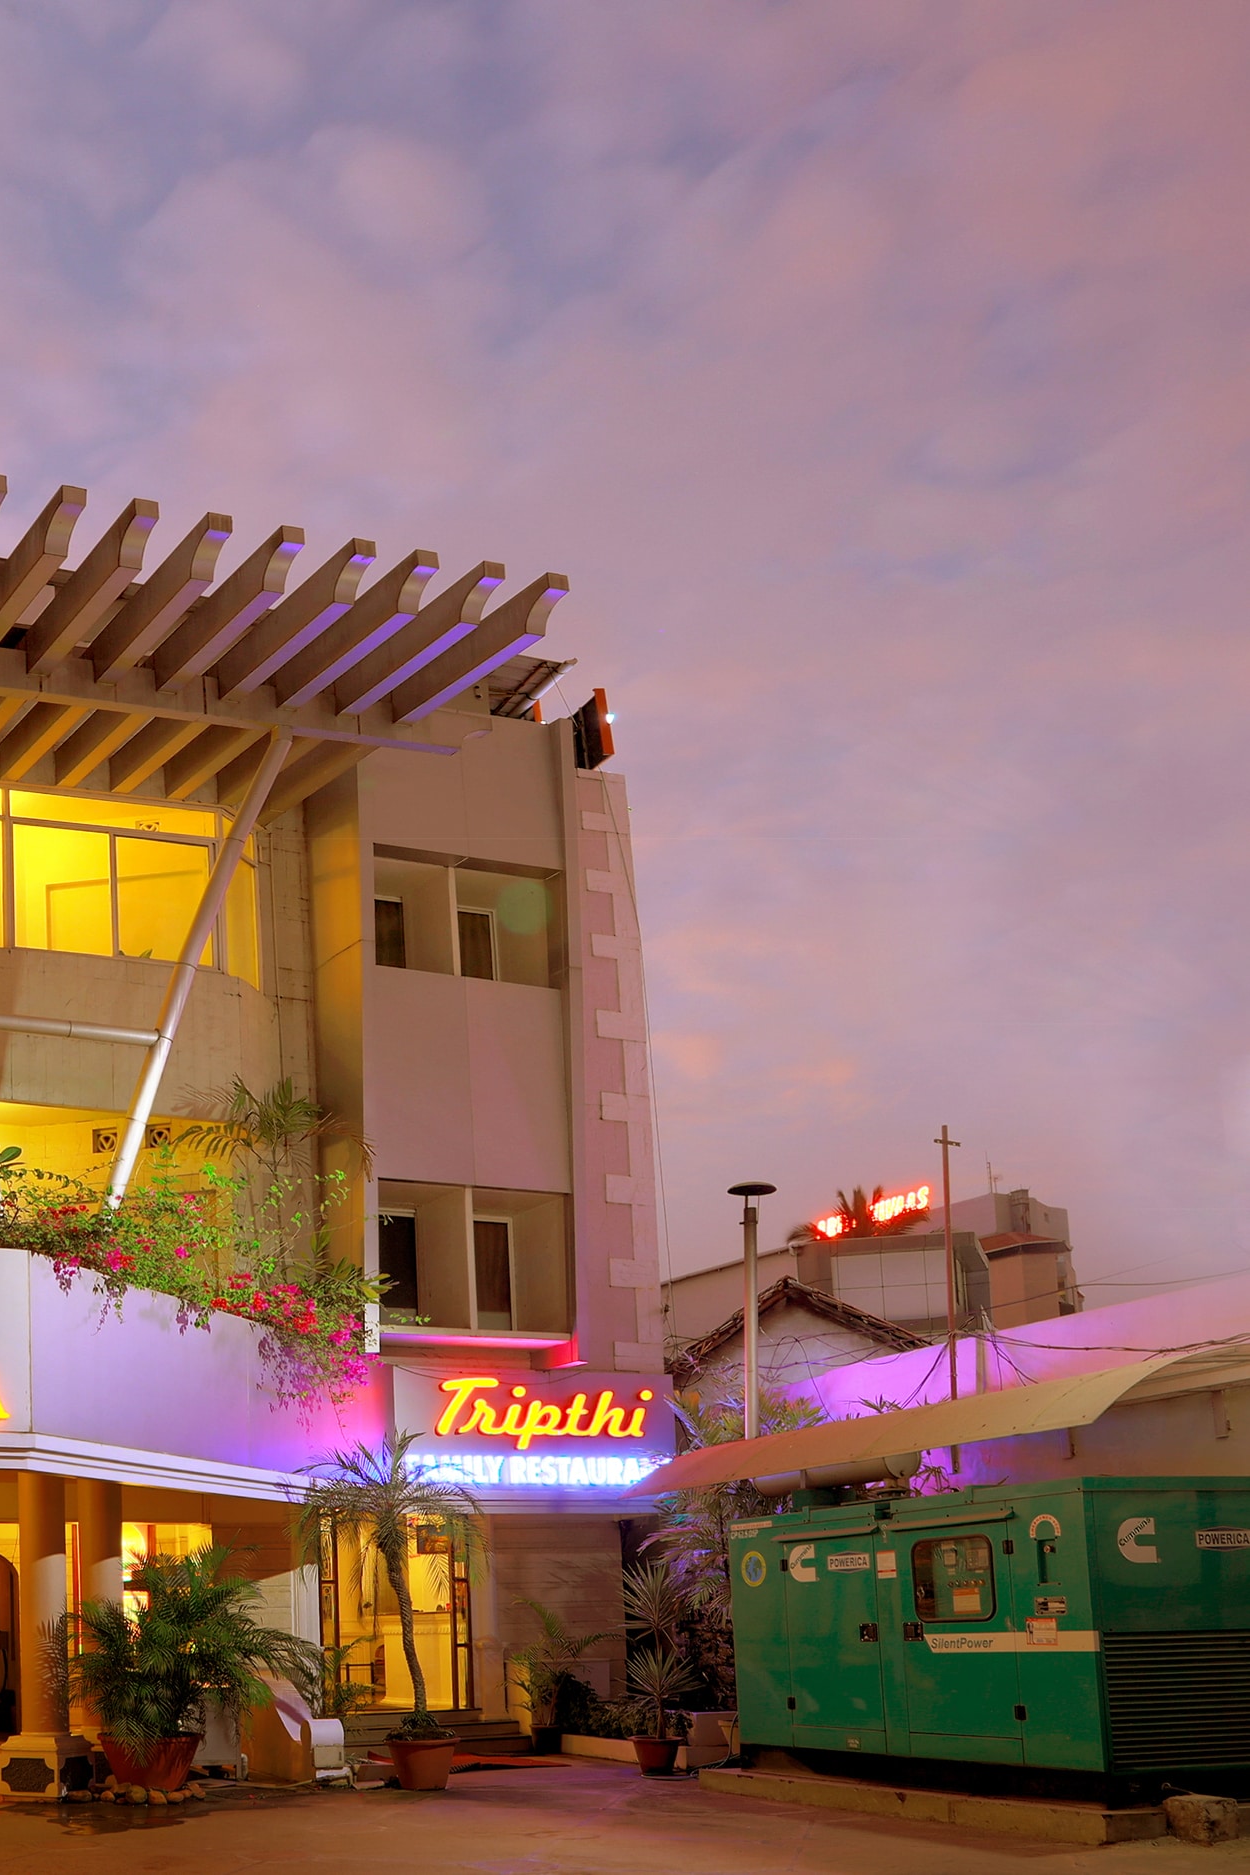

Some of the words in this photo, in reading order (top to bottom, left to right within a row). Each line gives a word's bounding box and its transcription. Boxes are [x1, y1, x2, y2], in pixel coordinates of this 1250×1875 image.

[437, 1377, 653, 1450] Tripthi
[1197, 1533, 1250, 1545] POWERICA
[829, 1556, 868, 1568] POWERICA
[931, 1637, 994, 1649] SilentPower
